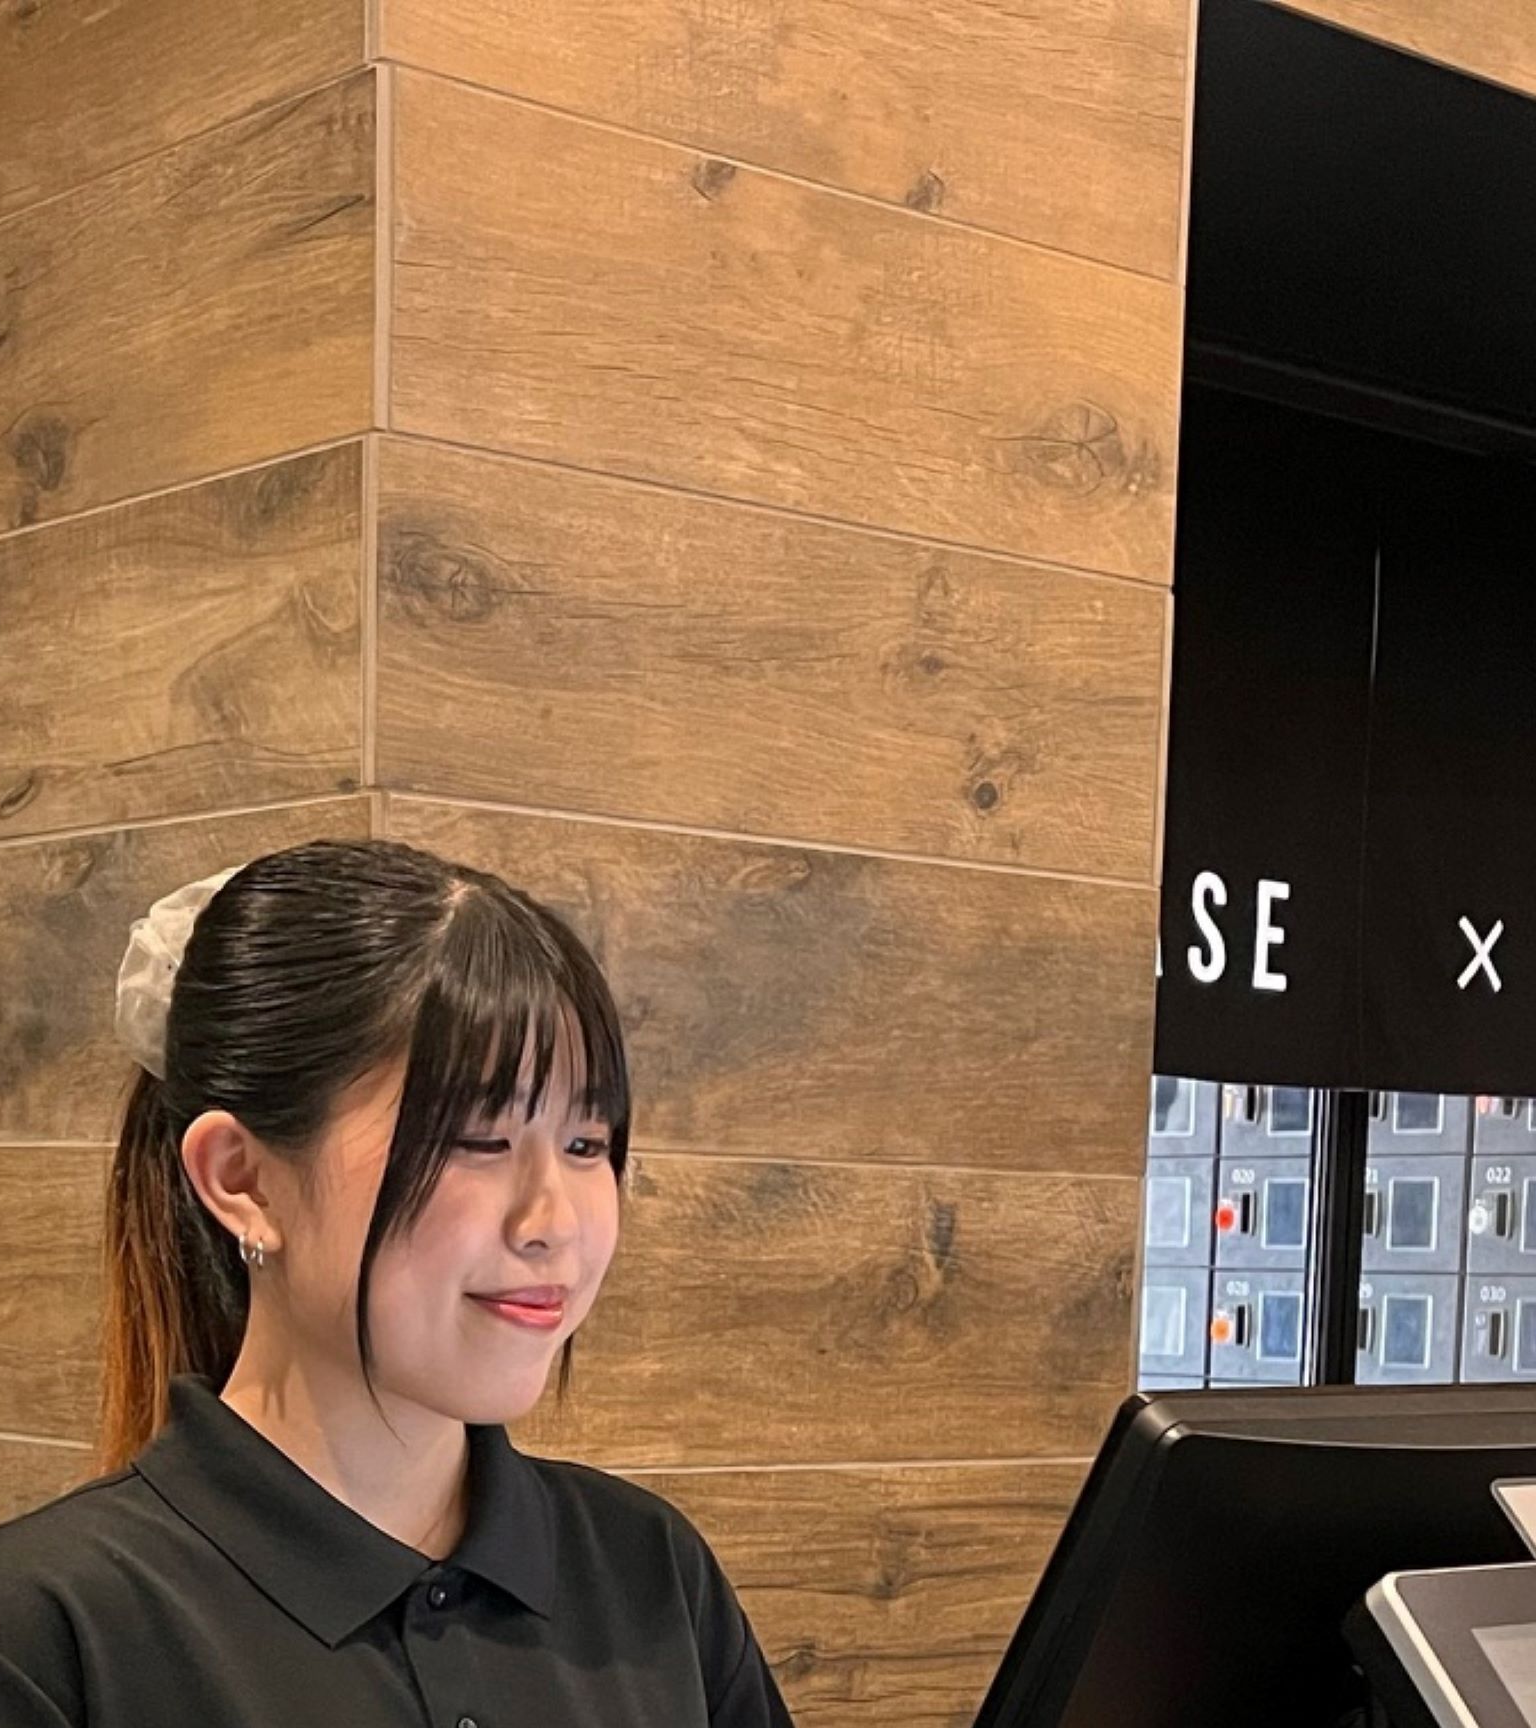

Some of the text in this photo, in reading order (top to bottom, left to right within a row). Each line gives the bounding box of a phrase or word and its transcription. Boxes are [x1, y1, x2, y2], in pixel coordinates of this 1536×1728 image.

[1155, 870, 1290, 992] SE
[1486, 1166, 1512, 1184] 022
[1480, 1285, 1506, 1302] 030
